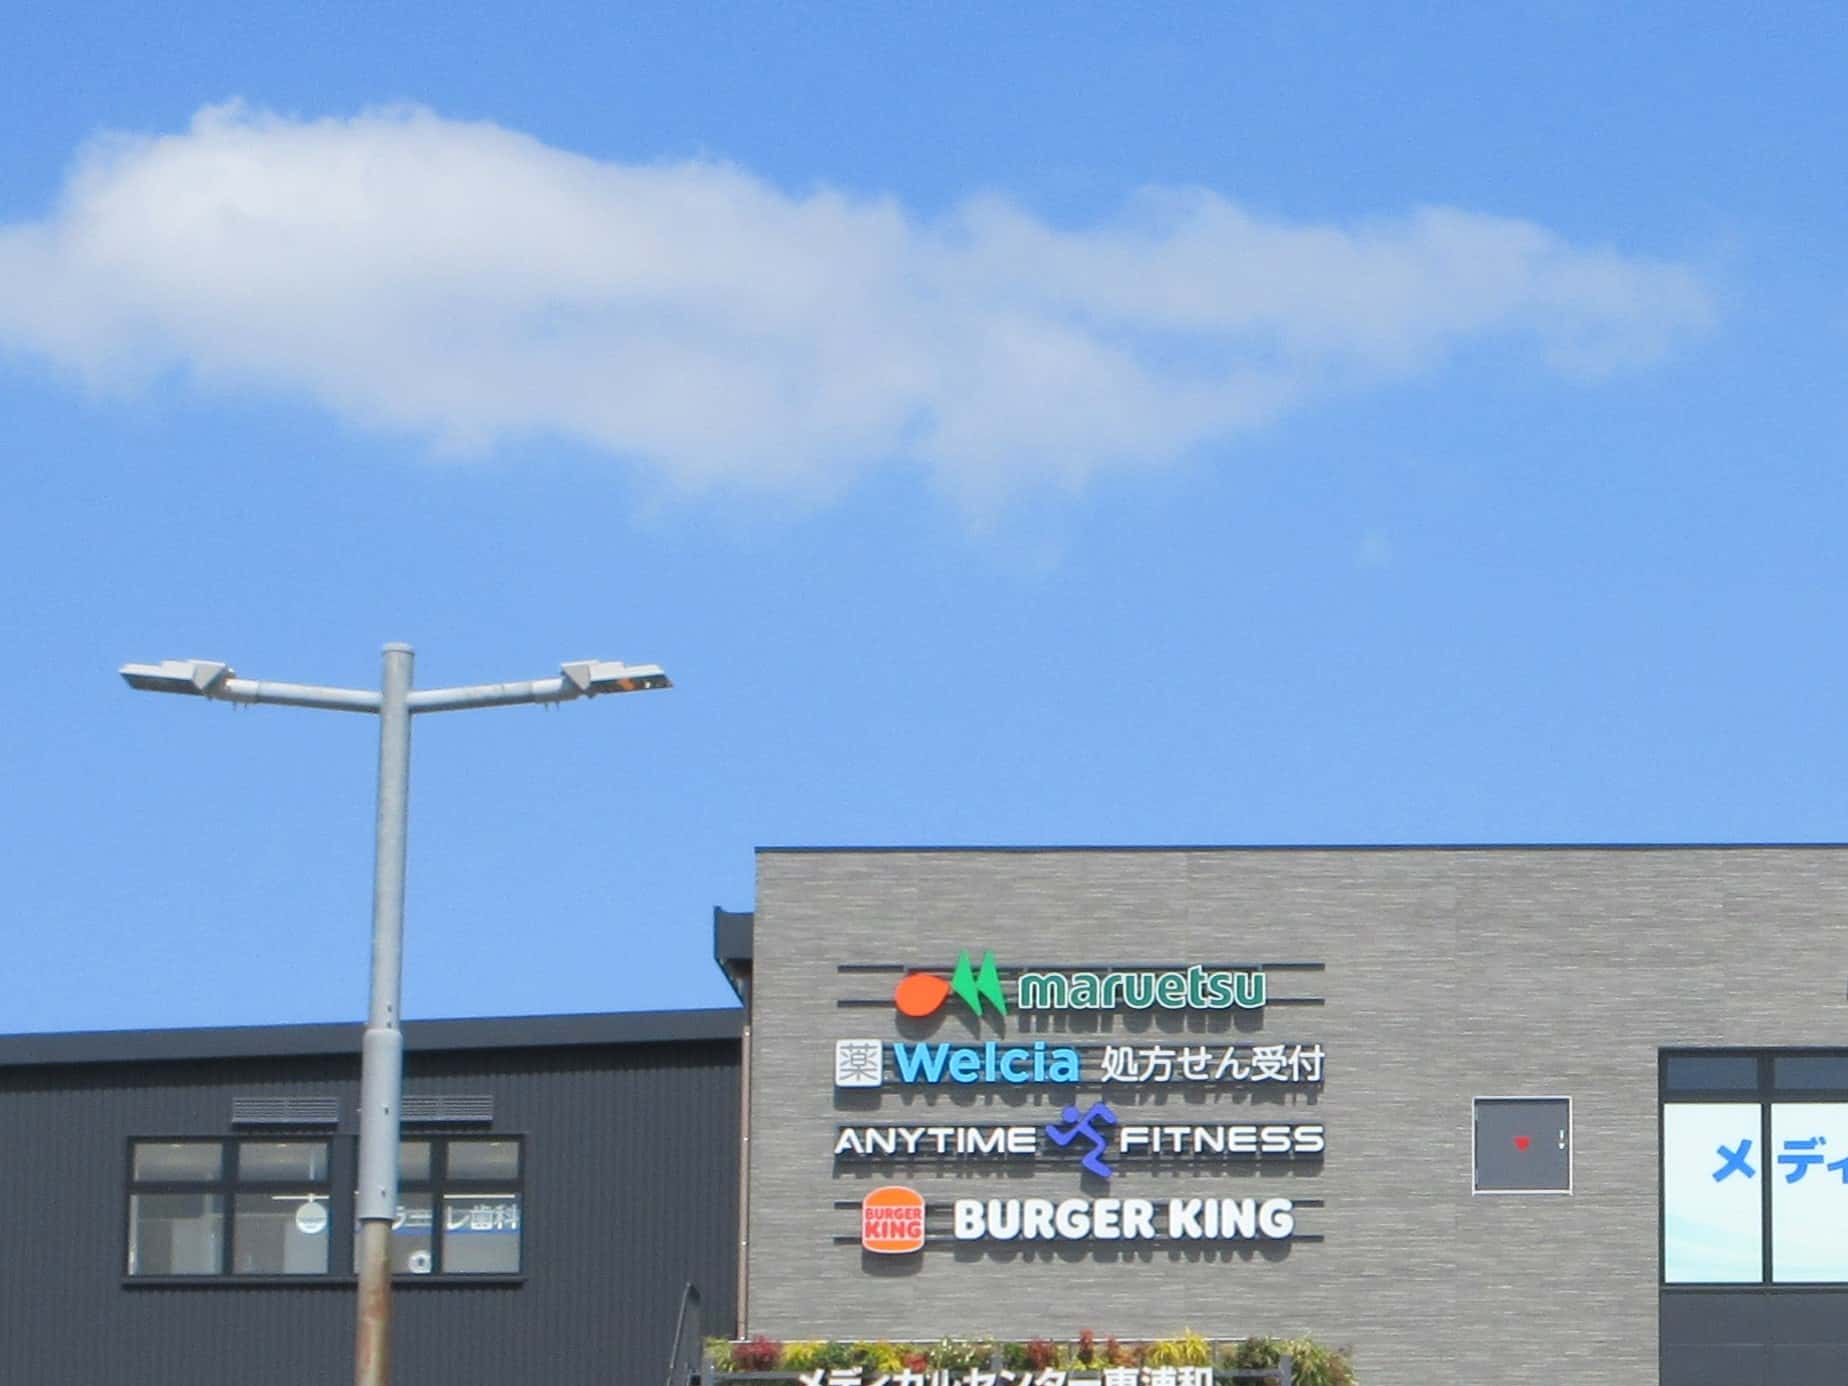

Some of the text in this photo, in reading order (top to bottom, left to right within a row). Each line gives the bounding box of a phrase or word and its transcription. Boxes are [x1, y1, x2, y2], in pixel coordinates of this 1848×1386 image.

[1018, 964, 1268, 1009] maruetsu
[838, 1042, 1325, 1084] 薬 Welcia 処方せん受付
[834, 1125, 1325, 1154] ANYTIME FITNESS
[864, 1207, 923, 1221] BURGER
[865, 1221, 922, 1239] KING
[954, 1198, 1294, 1240] BURGER KING
